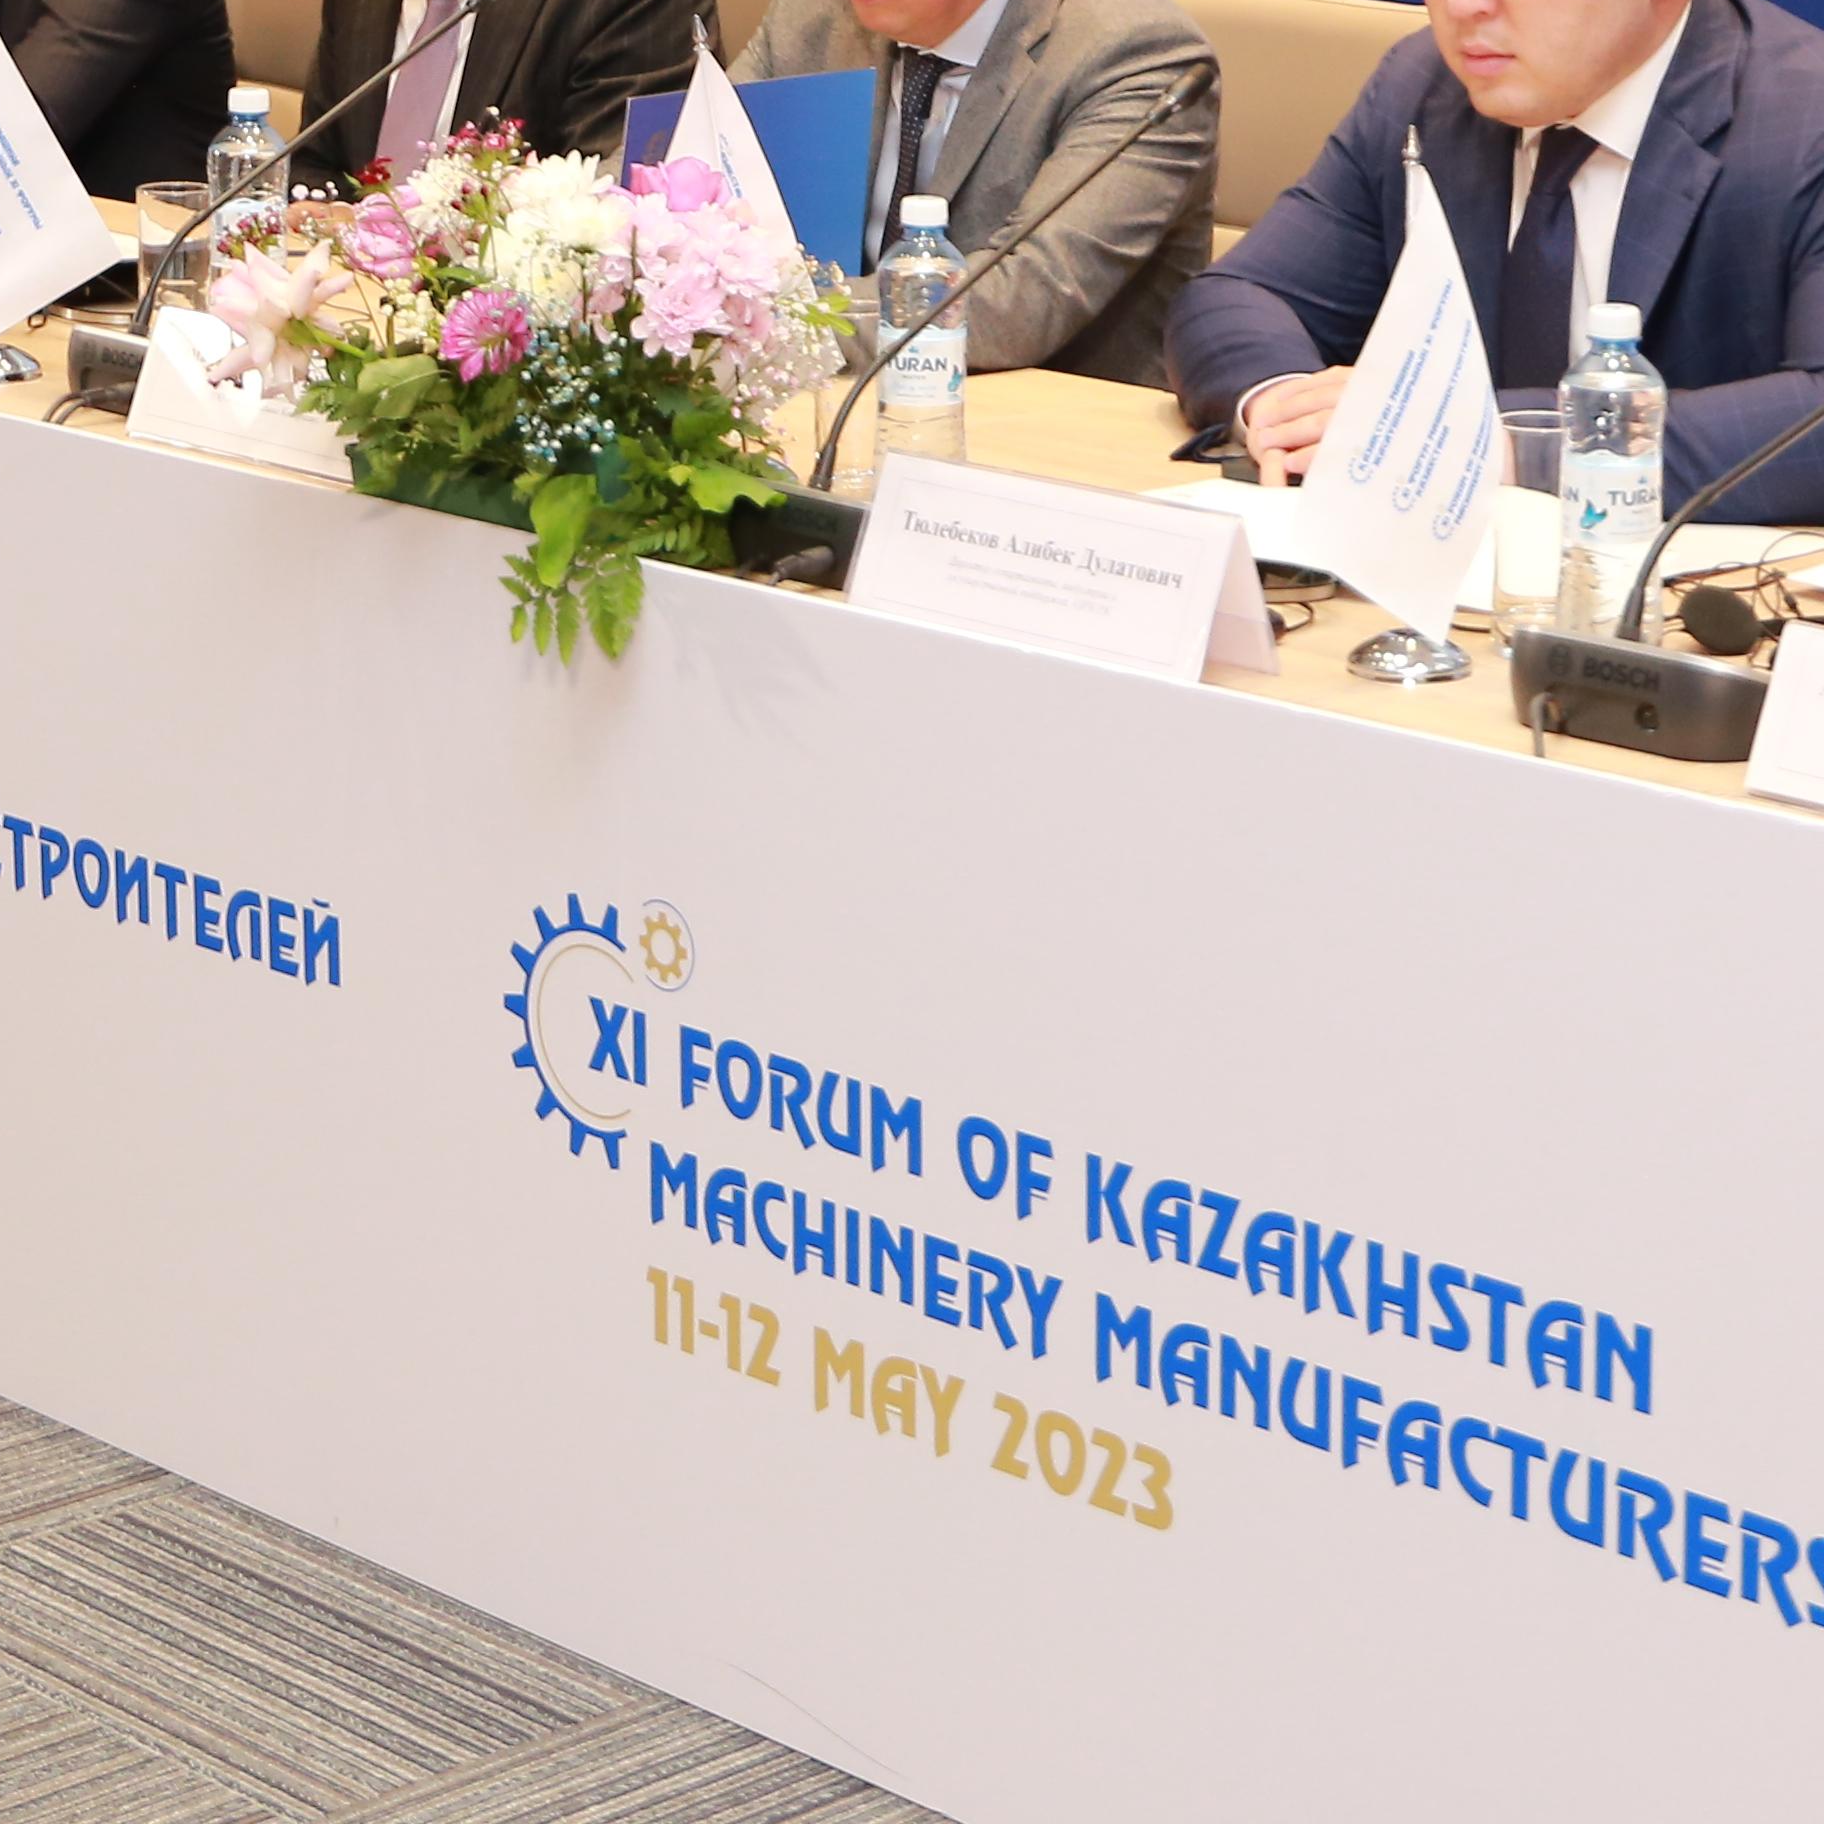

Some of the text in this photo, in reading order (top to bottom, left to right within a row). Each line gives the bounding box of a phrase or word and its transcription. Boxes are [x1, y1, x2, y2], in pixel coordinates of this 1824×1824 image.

[903, 509, 1000, 550] Тюлебеков
[1003, 532, 1076, 566] Алибек
[1077, 547, 1184, 591] Дулатович
[1582, 656, 1660, 690] BOSCH
[588, 994, 1654, 1415] XI FORUM OF KAZAKHSTAN
[649, 1142, 1062, 1360] MACHINERY
[646, 1266, 1174, 1533] 11-12 MAY 2023
